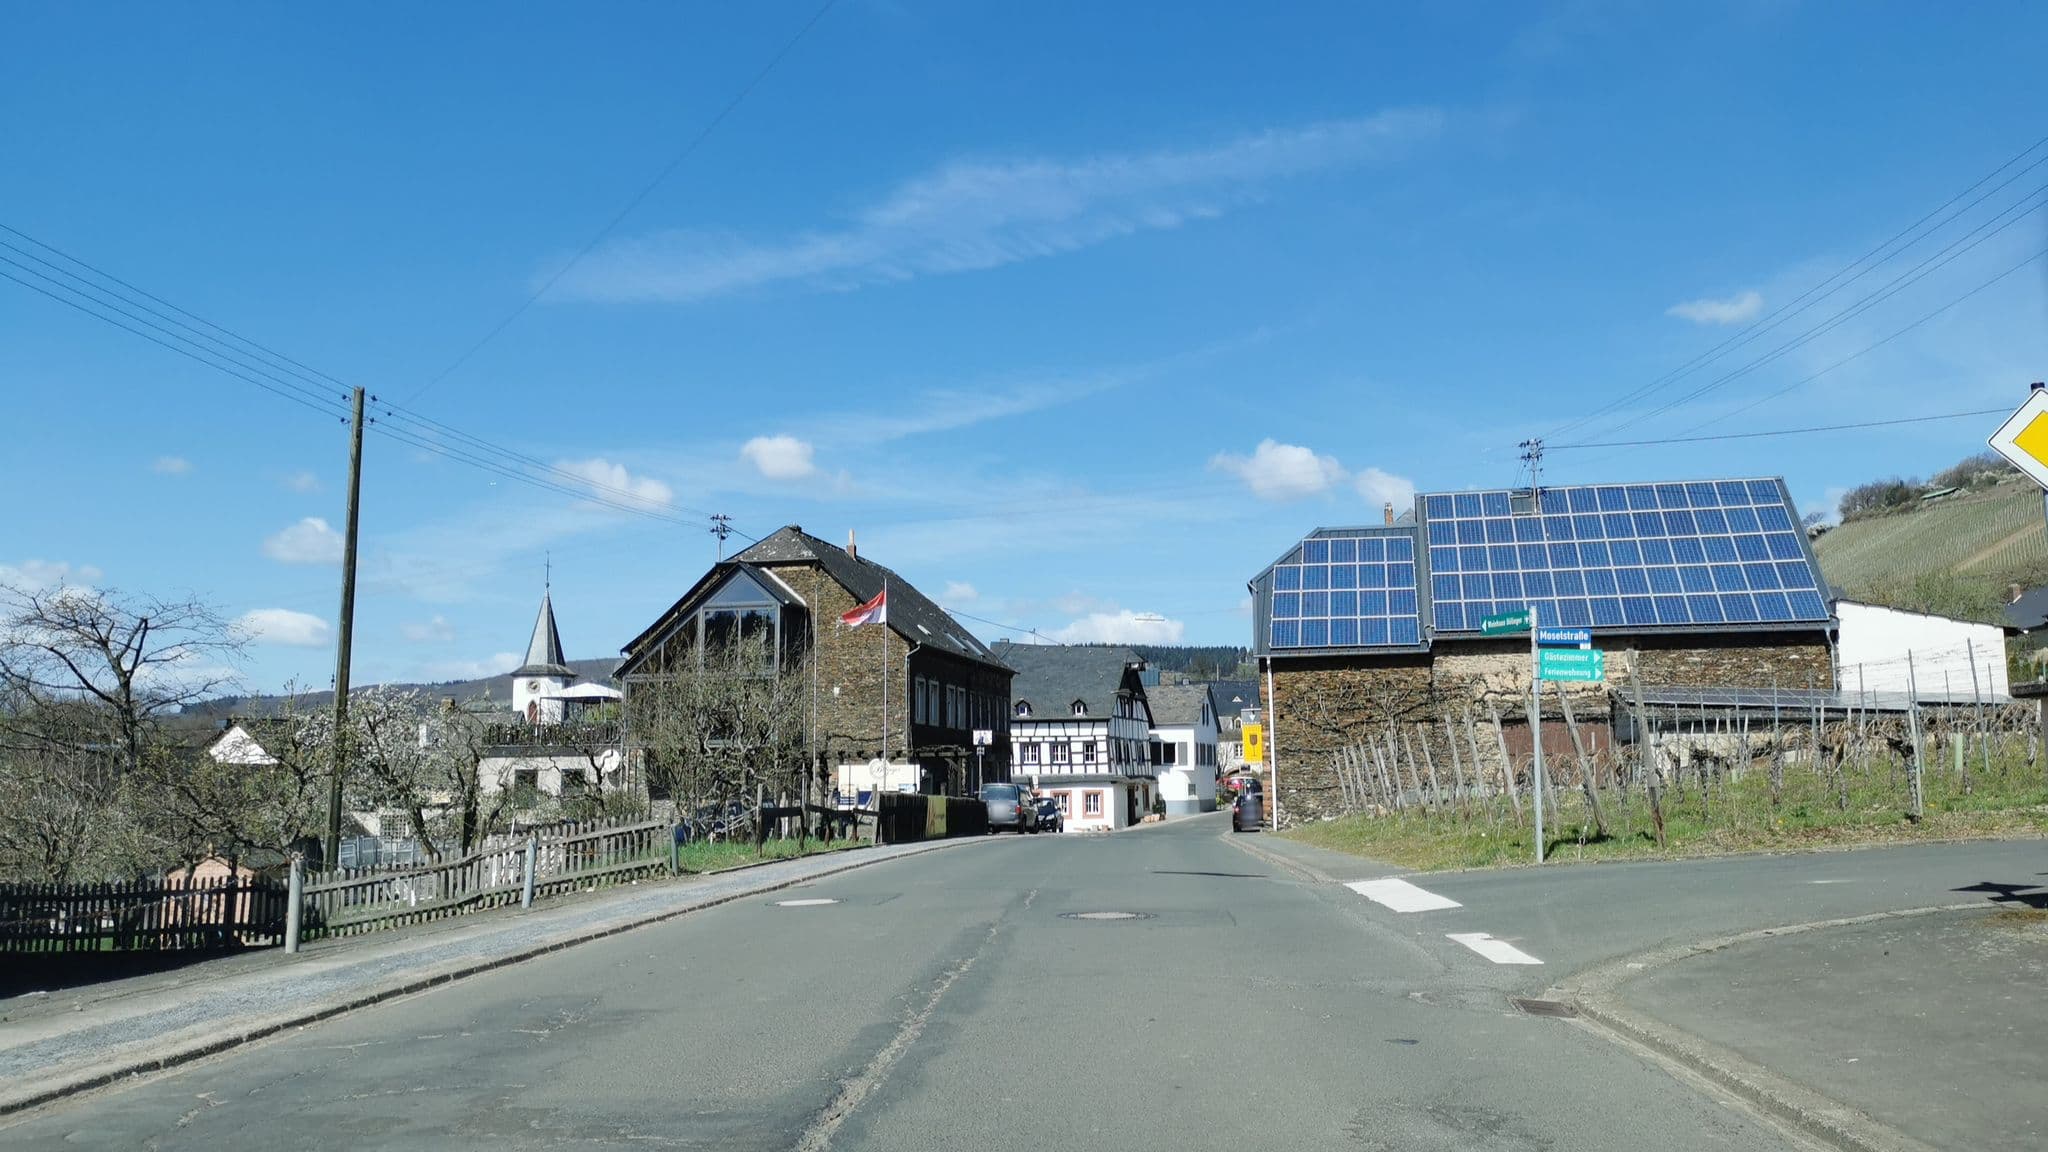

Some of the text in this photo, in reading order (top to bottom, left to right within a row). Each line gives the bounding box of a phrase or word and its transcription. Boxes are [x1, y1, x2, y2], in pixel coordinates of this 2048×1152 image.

[1540, 630, 1589, 641] Moselstraße
[1544, 652, 1589, 662] Gästezimmer
[1544, 667, 1591, 679] Ferienwohnung
